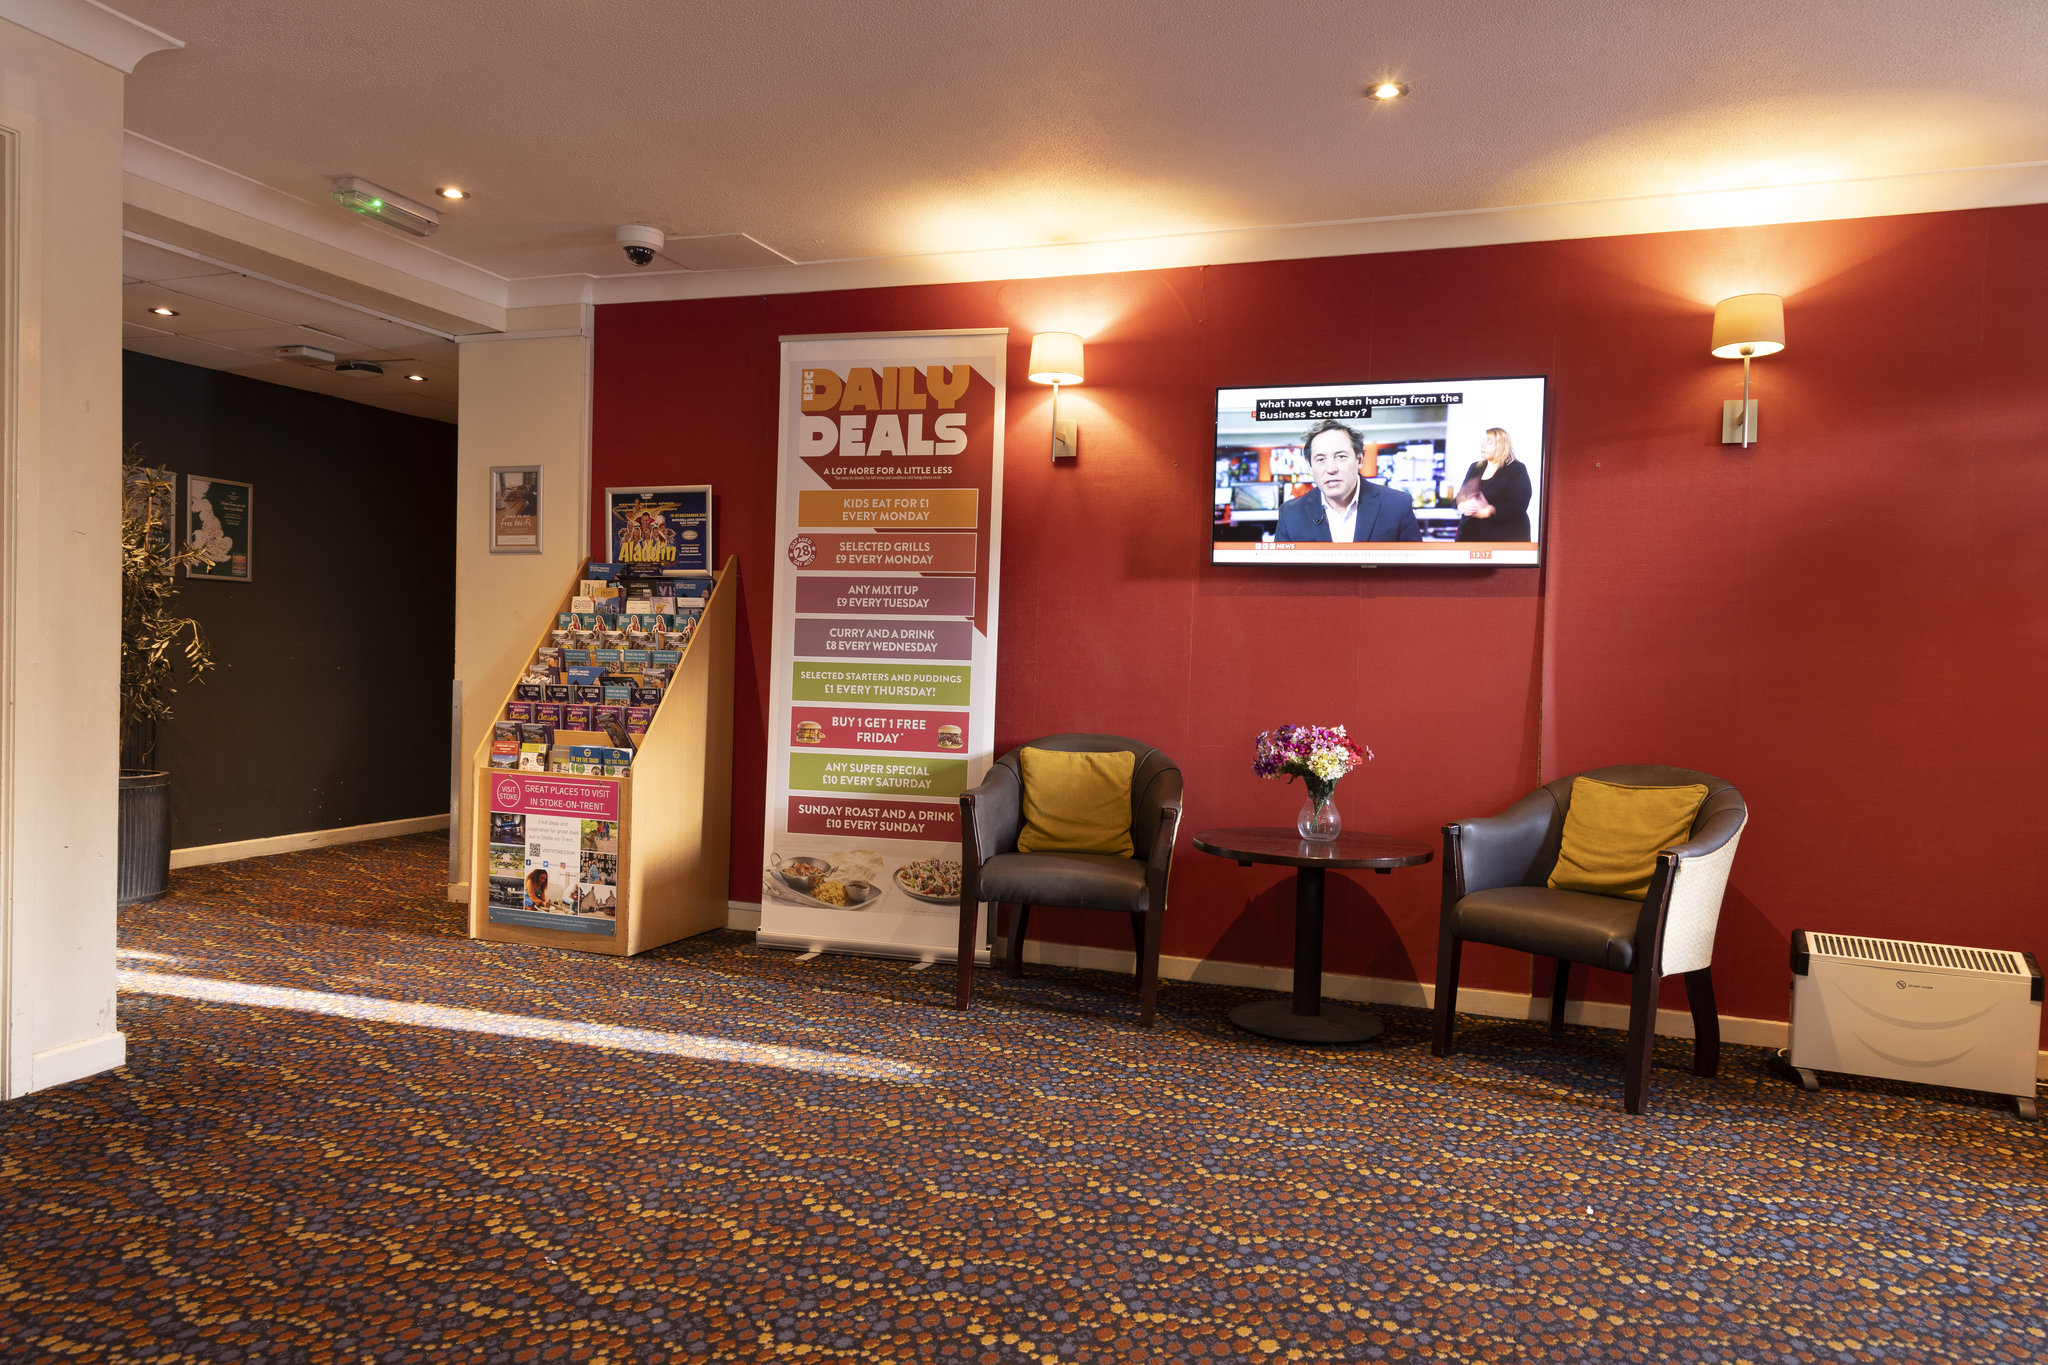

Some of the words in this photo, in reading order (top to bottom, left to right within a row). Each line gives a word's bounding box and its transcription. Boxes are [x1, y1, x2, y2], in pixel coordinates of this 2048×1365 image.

[801, 365, 970, 411] DAILY
[803, 371, 814, 401] EPIC
[1259, 400, 1285, 409] what
[1288, 399, 1313, 408] have
[1335, 397, 1362, 406] been
[1365, 396, 1406, 406] hearing
[1409, 395, 1437, 404] from
[1440, 394, 1459, 403] the
[1259, 410, 1306, 419] Business
[1309, 409, 1368, 419] Secretary?
[799, 413, 968, 457] DEALS
[832, 467, 847, 475] LOT
[933, 466, 953, 474] LESS
[844, 499, 869, 508] KIDS
[872, 499, 891, 508] EAT
[894, 499, 917, 508] FOR
[920, 499, 929, 508] £1
[842, 511, 877, 521] EVERY
[880, 511, 930, 521] MONDAY
[790, 539, 798, 550] DAY
[798, 537, 812, 545] AGED
[839, 542, 892, 552] SELECTED
[894, 542, 930, 552] GRILLS
[618, 541, 677, 562] Aladdin
[795, 545, 810, 558] 28
[836, 555, 847, 564] £9
[849, 555, 883, 564] EVERY
[884, 555, 934, 565] MONDAY
[848, 586, 870, 595] ANY
[872, 586, 892, 595] MIX
[893, 586, 902, 595] IT
[904, 586, 919, 595] UP
[837, 597, 848, 607] £9
[849, 598, 883, 607] EVERY
[883, 598, 930, 608] TUESDAY
[829, 628, 865, 638] CURRY
[866, 628, 889, 638] AND
[891, 629, 899, 639] A
[900, 630, 935, 639] DRINK
[826, 640, 837, 650] £8
[838, 641, 871, 651] EVERY
[872, 642, 938, 652] WEDNESDAY
[800, 671, 844, 680] SELECTED
[846, 672, 889, 681] STARTERS
[891, 673, 911, 682] AND
[913, 674, 962, 684] PUDDINGS
[824, 684, 834, 694] £1
[836, 685, 871, 695] EVERY
[873, 686, 936, 697] THURSDAY!
[831, 716, 855, 728] BUY
[857, 717, 862, 728] 1
[864, 717, 886, 729] GET
[889, 718, 893, 729] 1
[896, 718, 926, 730] FREE
[825, 763, 848, 772] ANY
[850, 763, 884, 774] SUPER
[886, 764, 930, 776] SPECIAL
[822, 775, 838, 785] £10
[840, 776, 874, 786] EVERY
[875, 777, 932, 789] SATURDAY
[501, 785, 516, 793] VISIT
[525, 784, 549, 794] GREAT
[550, 786, 579, 795] PLACES
[580, 788, 590, 797] TO
[591, 789, 610, 798] VISIT
[530, 798, 538, 806] IN
[539, 798, 604, 811] STOKE-ON-TRENT
[798, 804, 843, 816] SUNDAY
[845, 806, 880, 818] ROAST
[881, 809, 906, 820] AND
[908, 810, 916, 820] A
[918, 811, 954, 822] DRINK
[826, 818, 841, 829] £10
[844, 819, 877, 831] EVERY
[879, 821, 926, 833] SUNDAY
